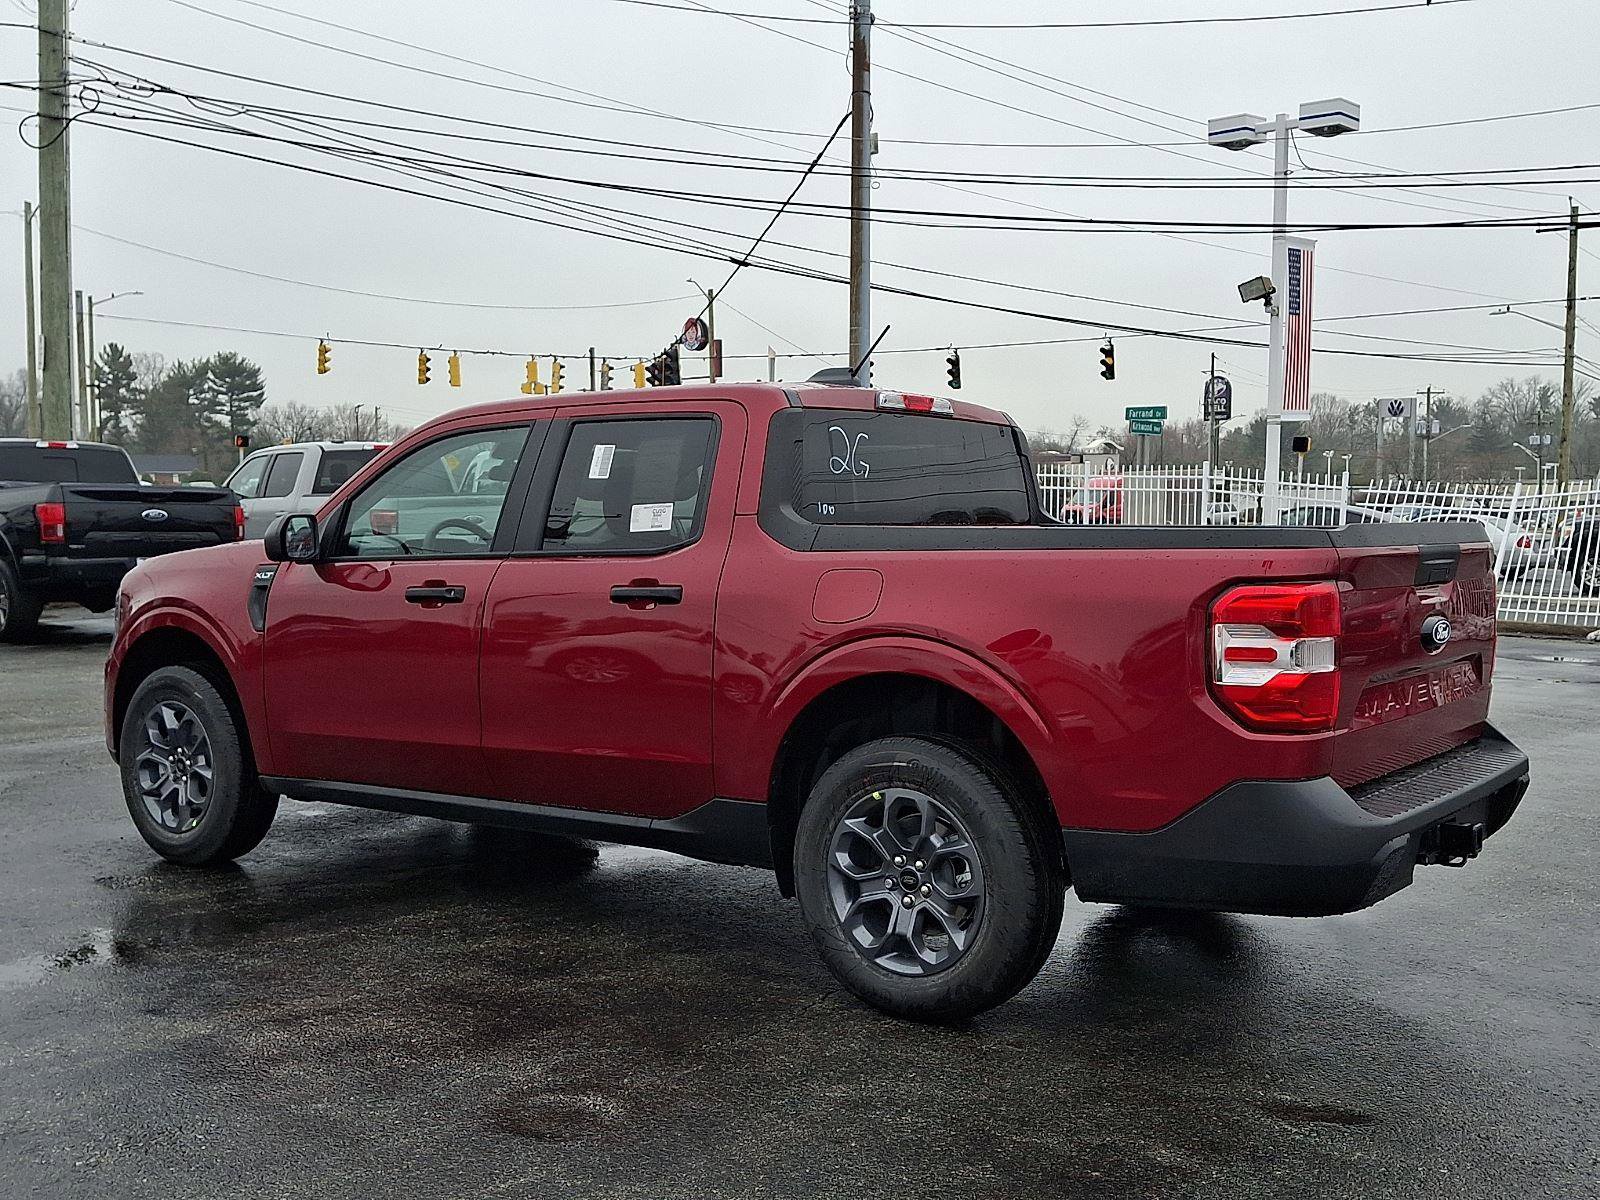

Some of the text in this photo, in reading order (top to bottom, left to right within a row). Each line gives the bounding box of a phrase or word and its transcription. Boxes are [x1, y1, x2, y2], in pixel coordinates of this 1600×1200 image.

[1128, 409, 1154, 418] Farrand
[255, 571, 274, 579] XLT
[1436, 622, 1450, 641] Ford
